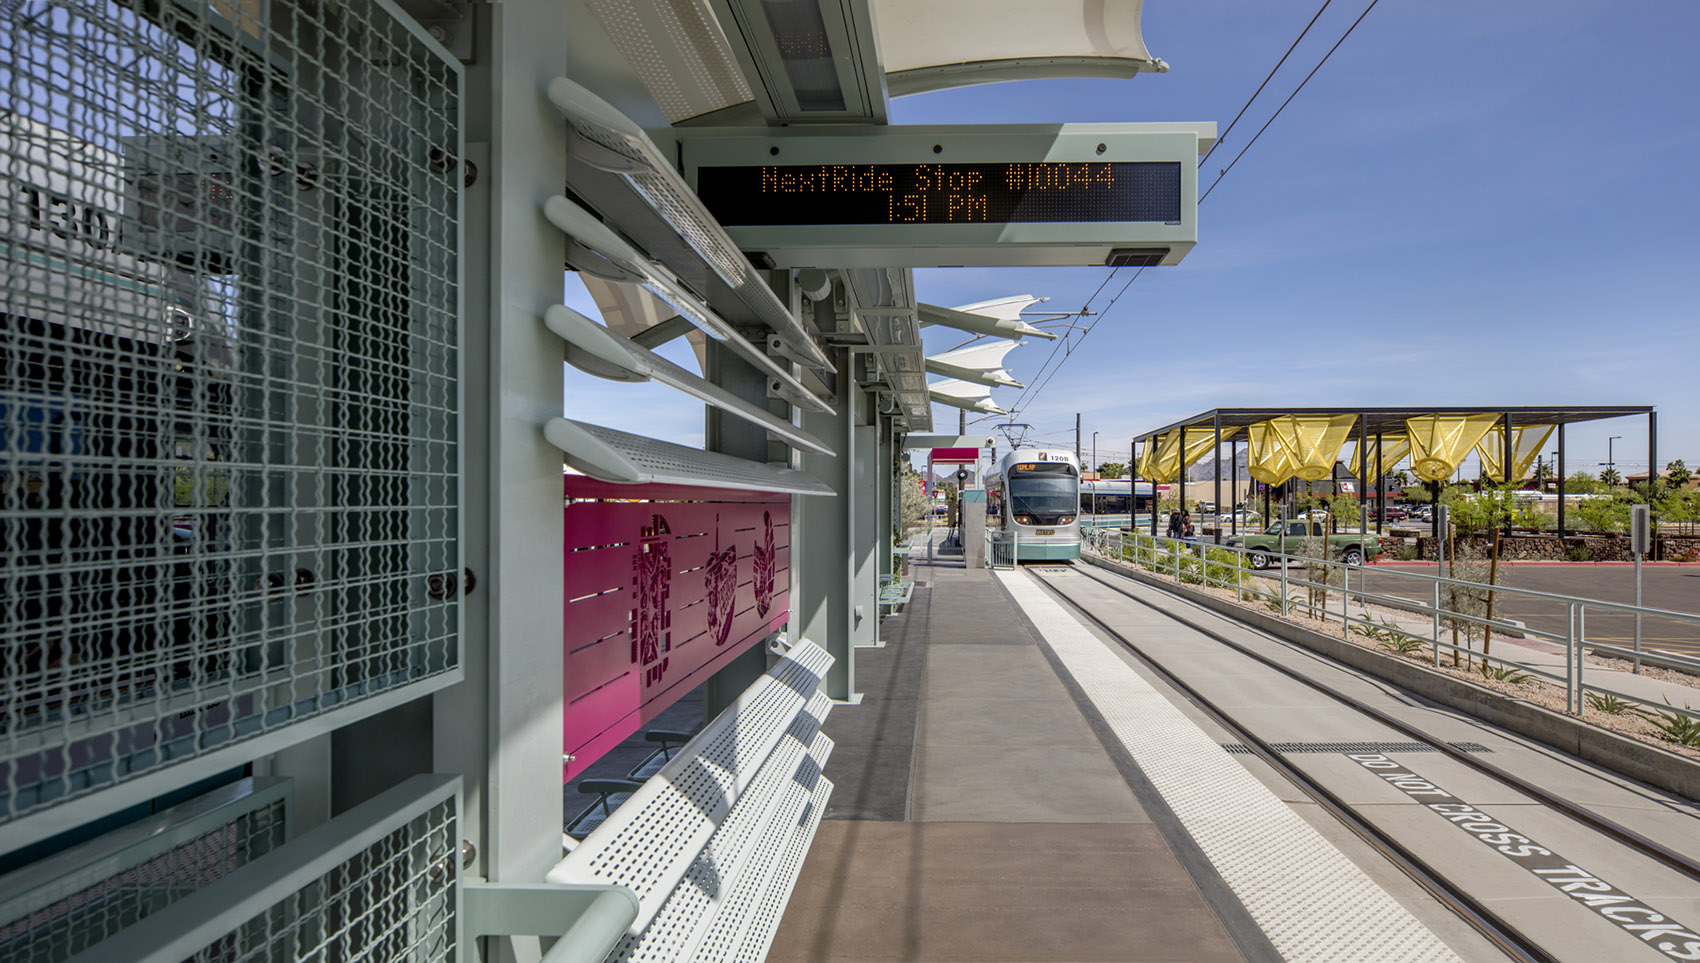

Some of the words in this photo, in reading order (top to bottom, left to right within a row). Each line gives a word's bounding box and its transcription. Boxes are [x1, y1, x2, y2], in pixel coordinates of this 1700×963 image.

[762, 166, 893, 193] NextRide
[915, 164, 984, 191] Stop
[1005, 163, 1115, 191] #10044
[888, 195, 928, 221] 1:51
[949, 194, 987, 220] PM
[1347, 754, 1400, 768] DO
[1377, 773, 1451, 797] NOT
[1428, 803, 1552, 857] CROSS
